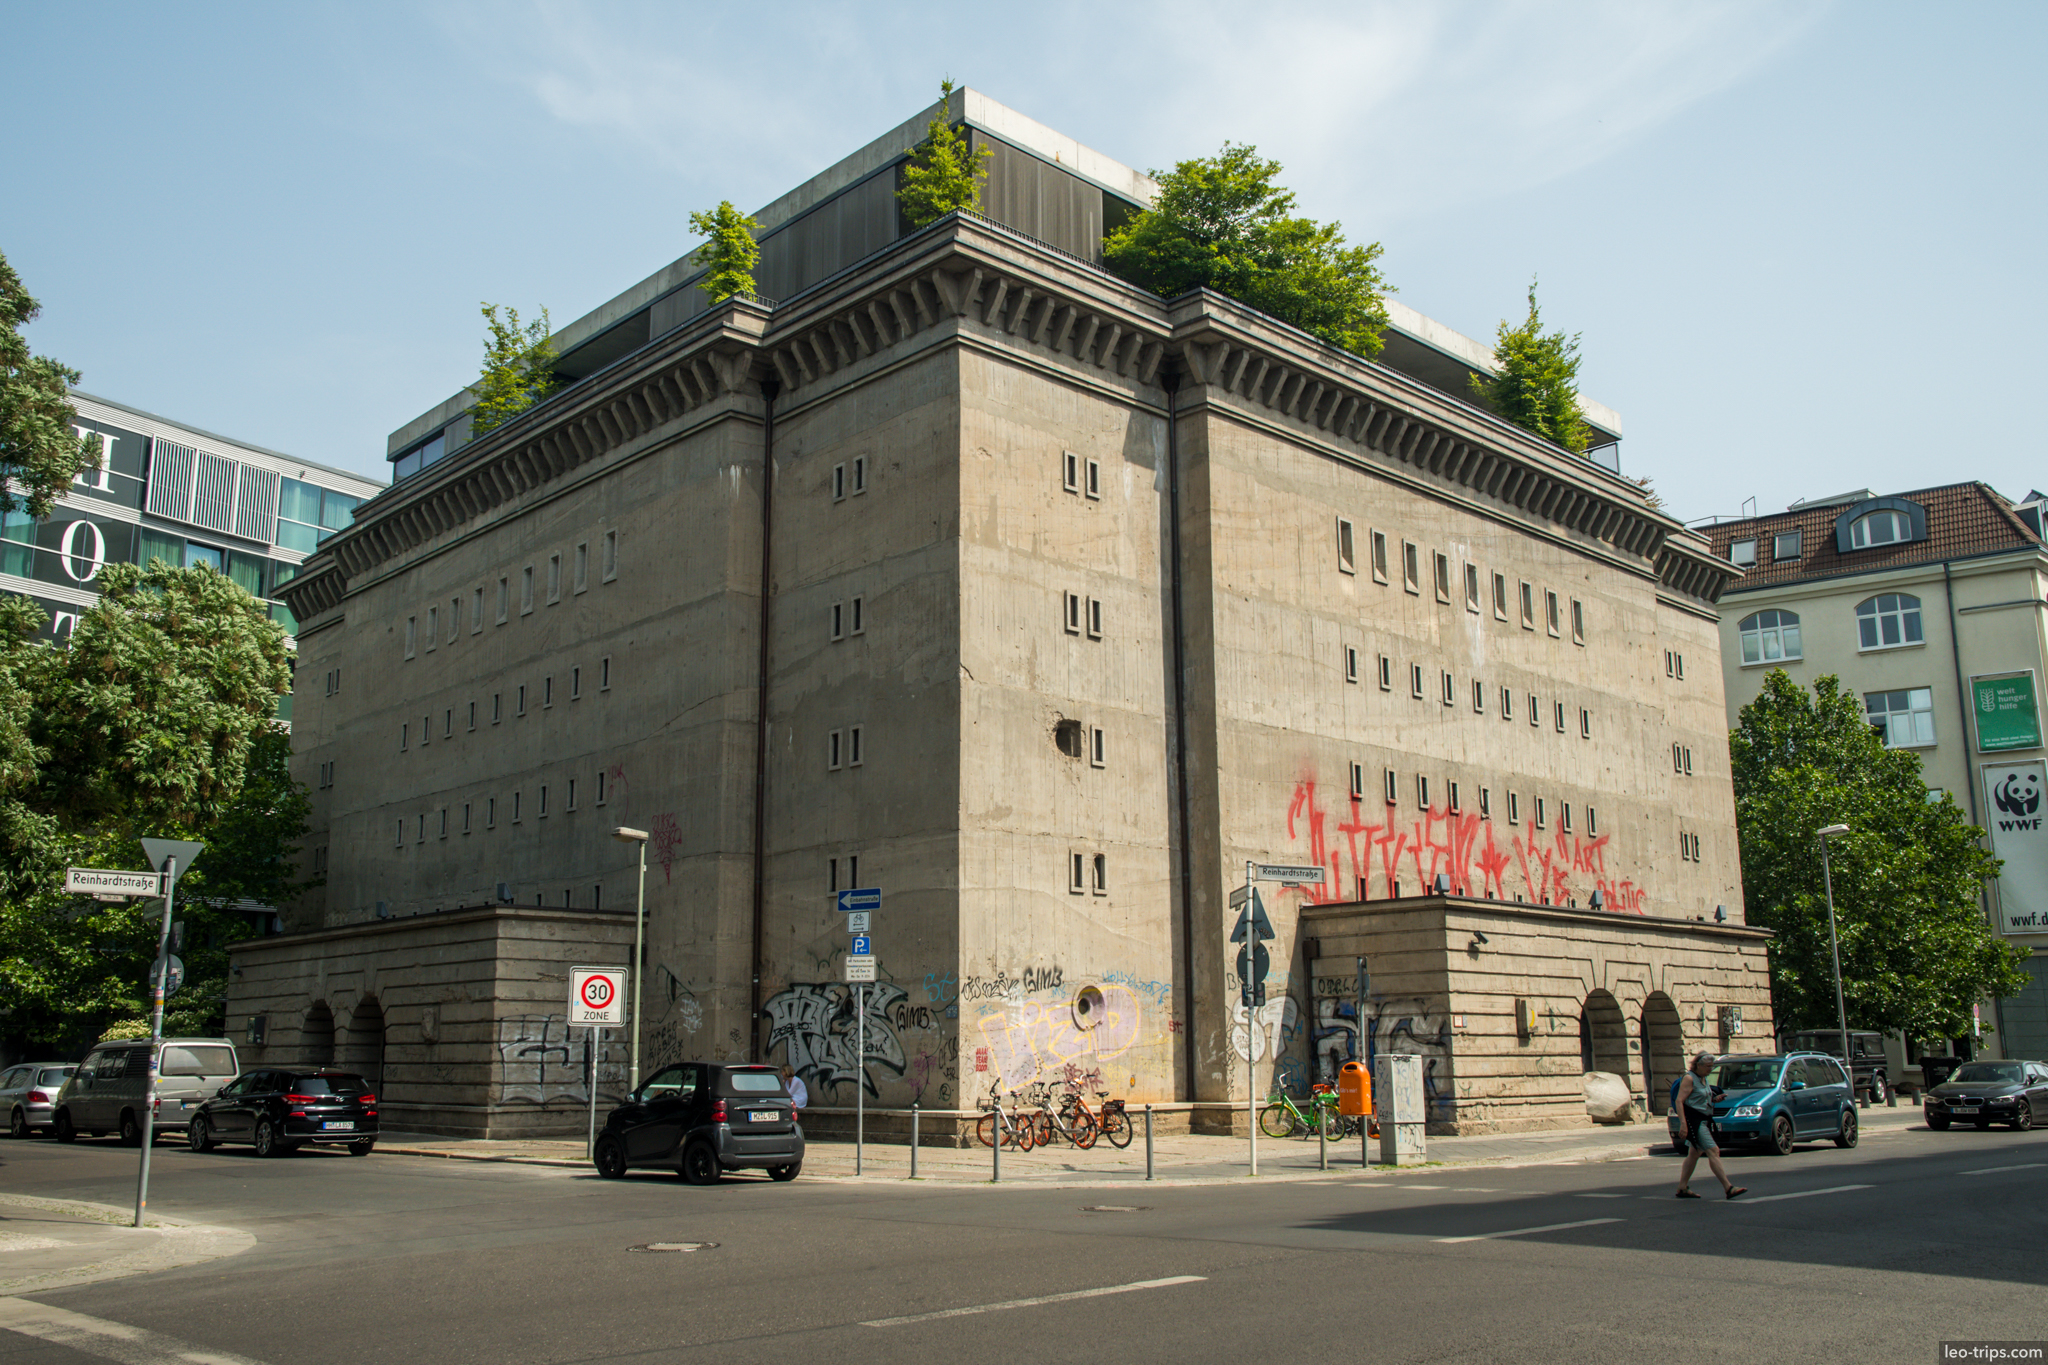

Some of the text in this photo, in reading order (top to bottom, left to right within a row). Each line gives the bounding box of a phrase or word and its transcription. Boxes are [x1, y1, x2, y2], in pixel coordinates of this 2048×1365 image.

[1996, 687, 2016, 696] welt
[1998, 694, 2027, 703] hunger
[1999, 702, 2018, 711] hilfe
[1998, 819, 2042, 832] WWF
[1573, 834, 1610, 873] ART
[1262, 867, 1319, 879] Reinhardtstraße
[72, 872, 154, 890] Reinhardtstraße
[588, 984, 608, 1000] 30
[583, 1011, 610, 1021] ZONE
